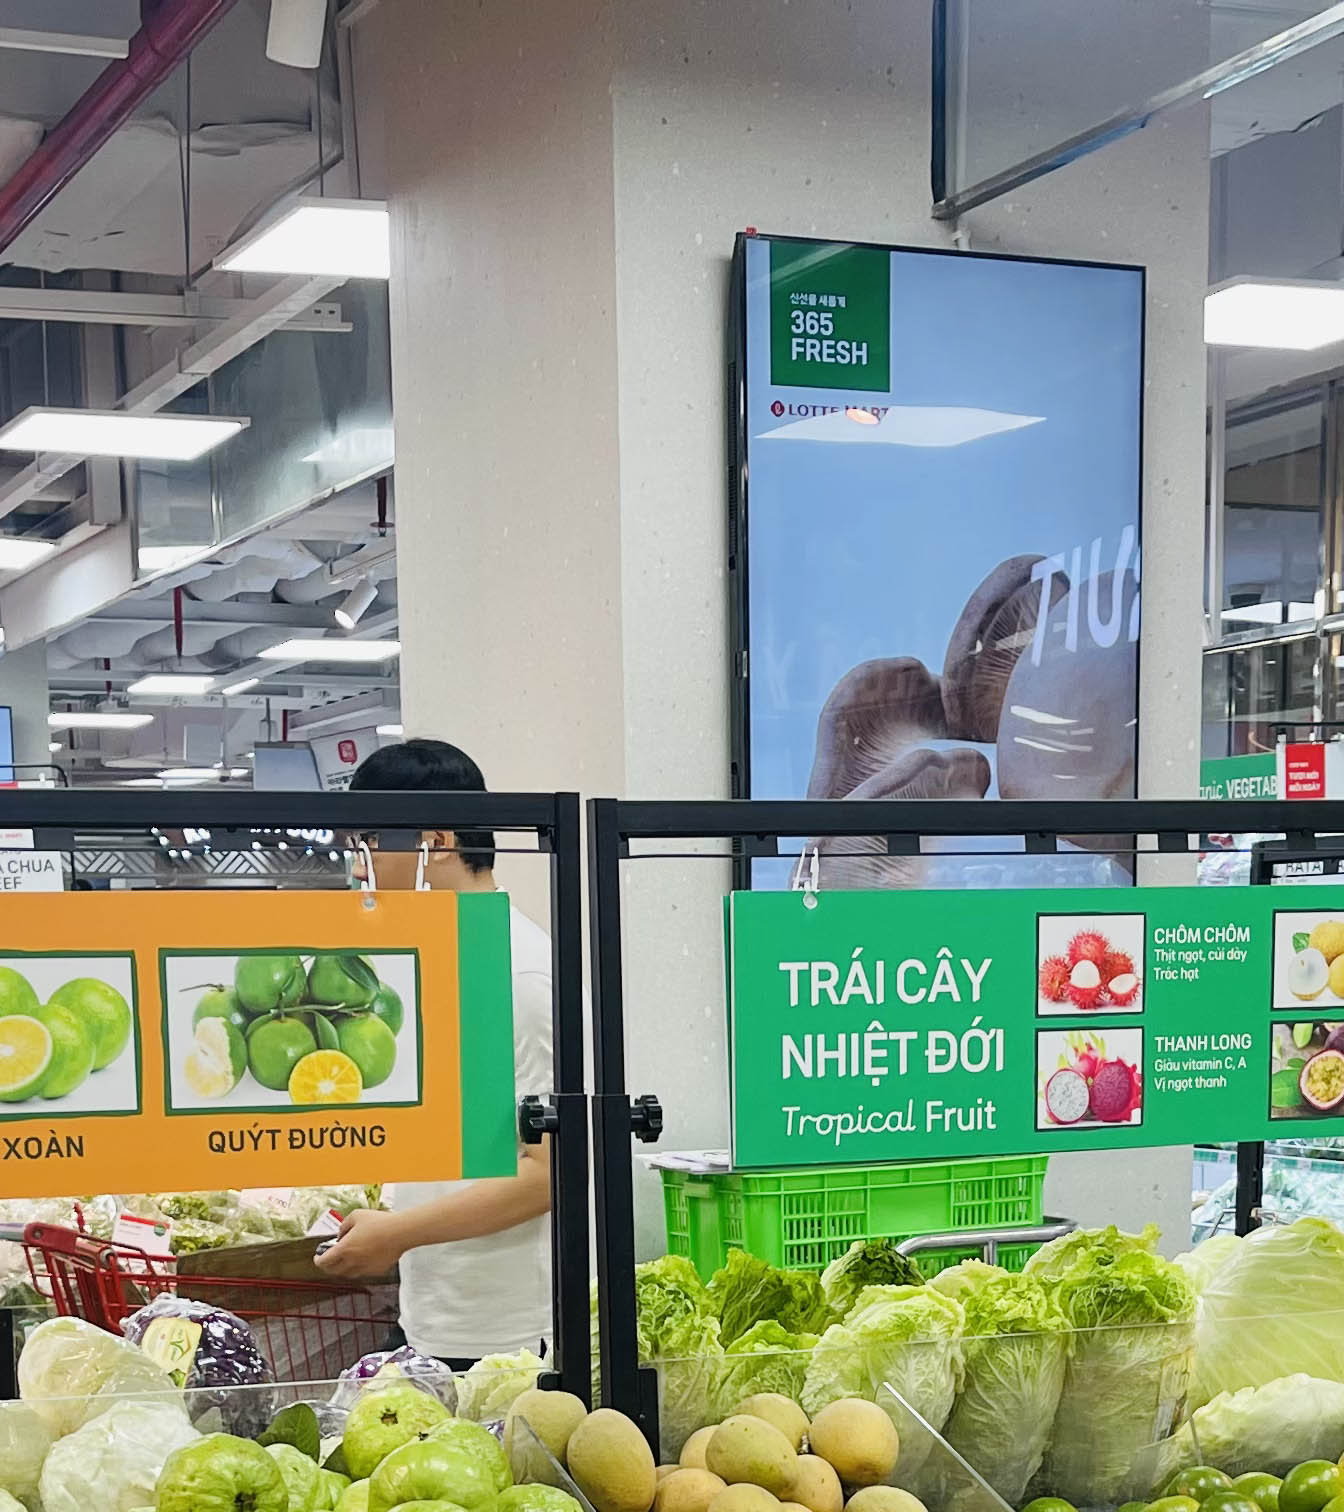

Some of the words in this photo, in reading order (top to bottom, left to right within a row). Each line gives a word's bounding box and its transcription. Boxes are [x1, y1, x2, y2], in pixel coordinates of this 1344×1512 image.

[791, 310, 833, 336] 365
[791, 337, 868, 365] FRESH
[1226, 776, 1277, 799] VEGETAB
[8, 859, 54, 873] CHUA
[1154, 923, 1201, 944] CHÔM
[1204, 922, 1250, 943] CHÔM
[778, 946, 885, 1008] TRÁI
[896, 946, 993, 1005] CÂY
[781, 1019, 918, 1087] NHIỆT
[924, 1015, 1005, 1073] ĐỚI
[1154, 1035, 1208, 1052] THANH
[1211, 1033, 1252, 1050] LONG
[1182, 1057, 1222, 1070] vitamin
[1224, 1056, 1236, 1071] C,
[1237, 1056, 1247, 1069] A
[1194, 1075, 1227, 1088] thanh
[781, 1099, 916, 1146] Tropical
[925, 1098, 997, 1132] Fruit
[2, 1129, 85, 1161] XOÀN
[208, 1121, 282, 1154] QUÝT
[287, 1120, 386, 1150] ĐƯỜNG
